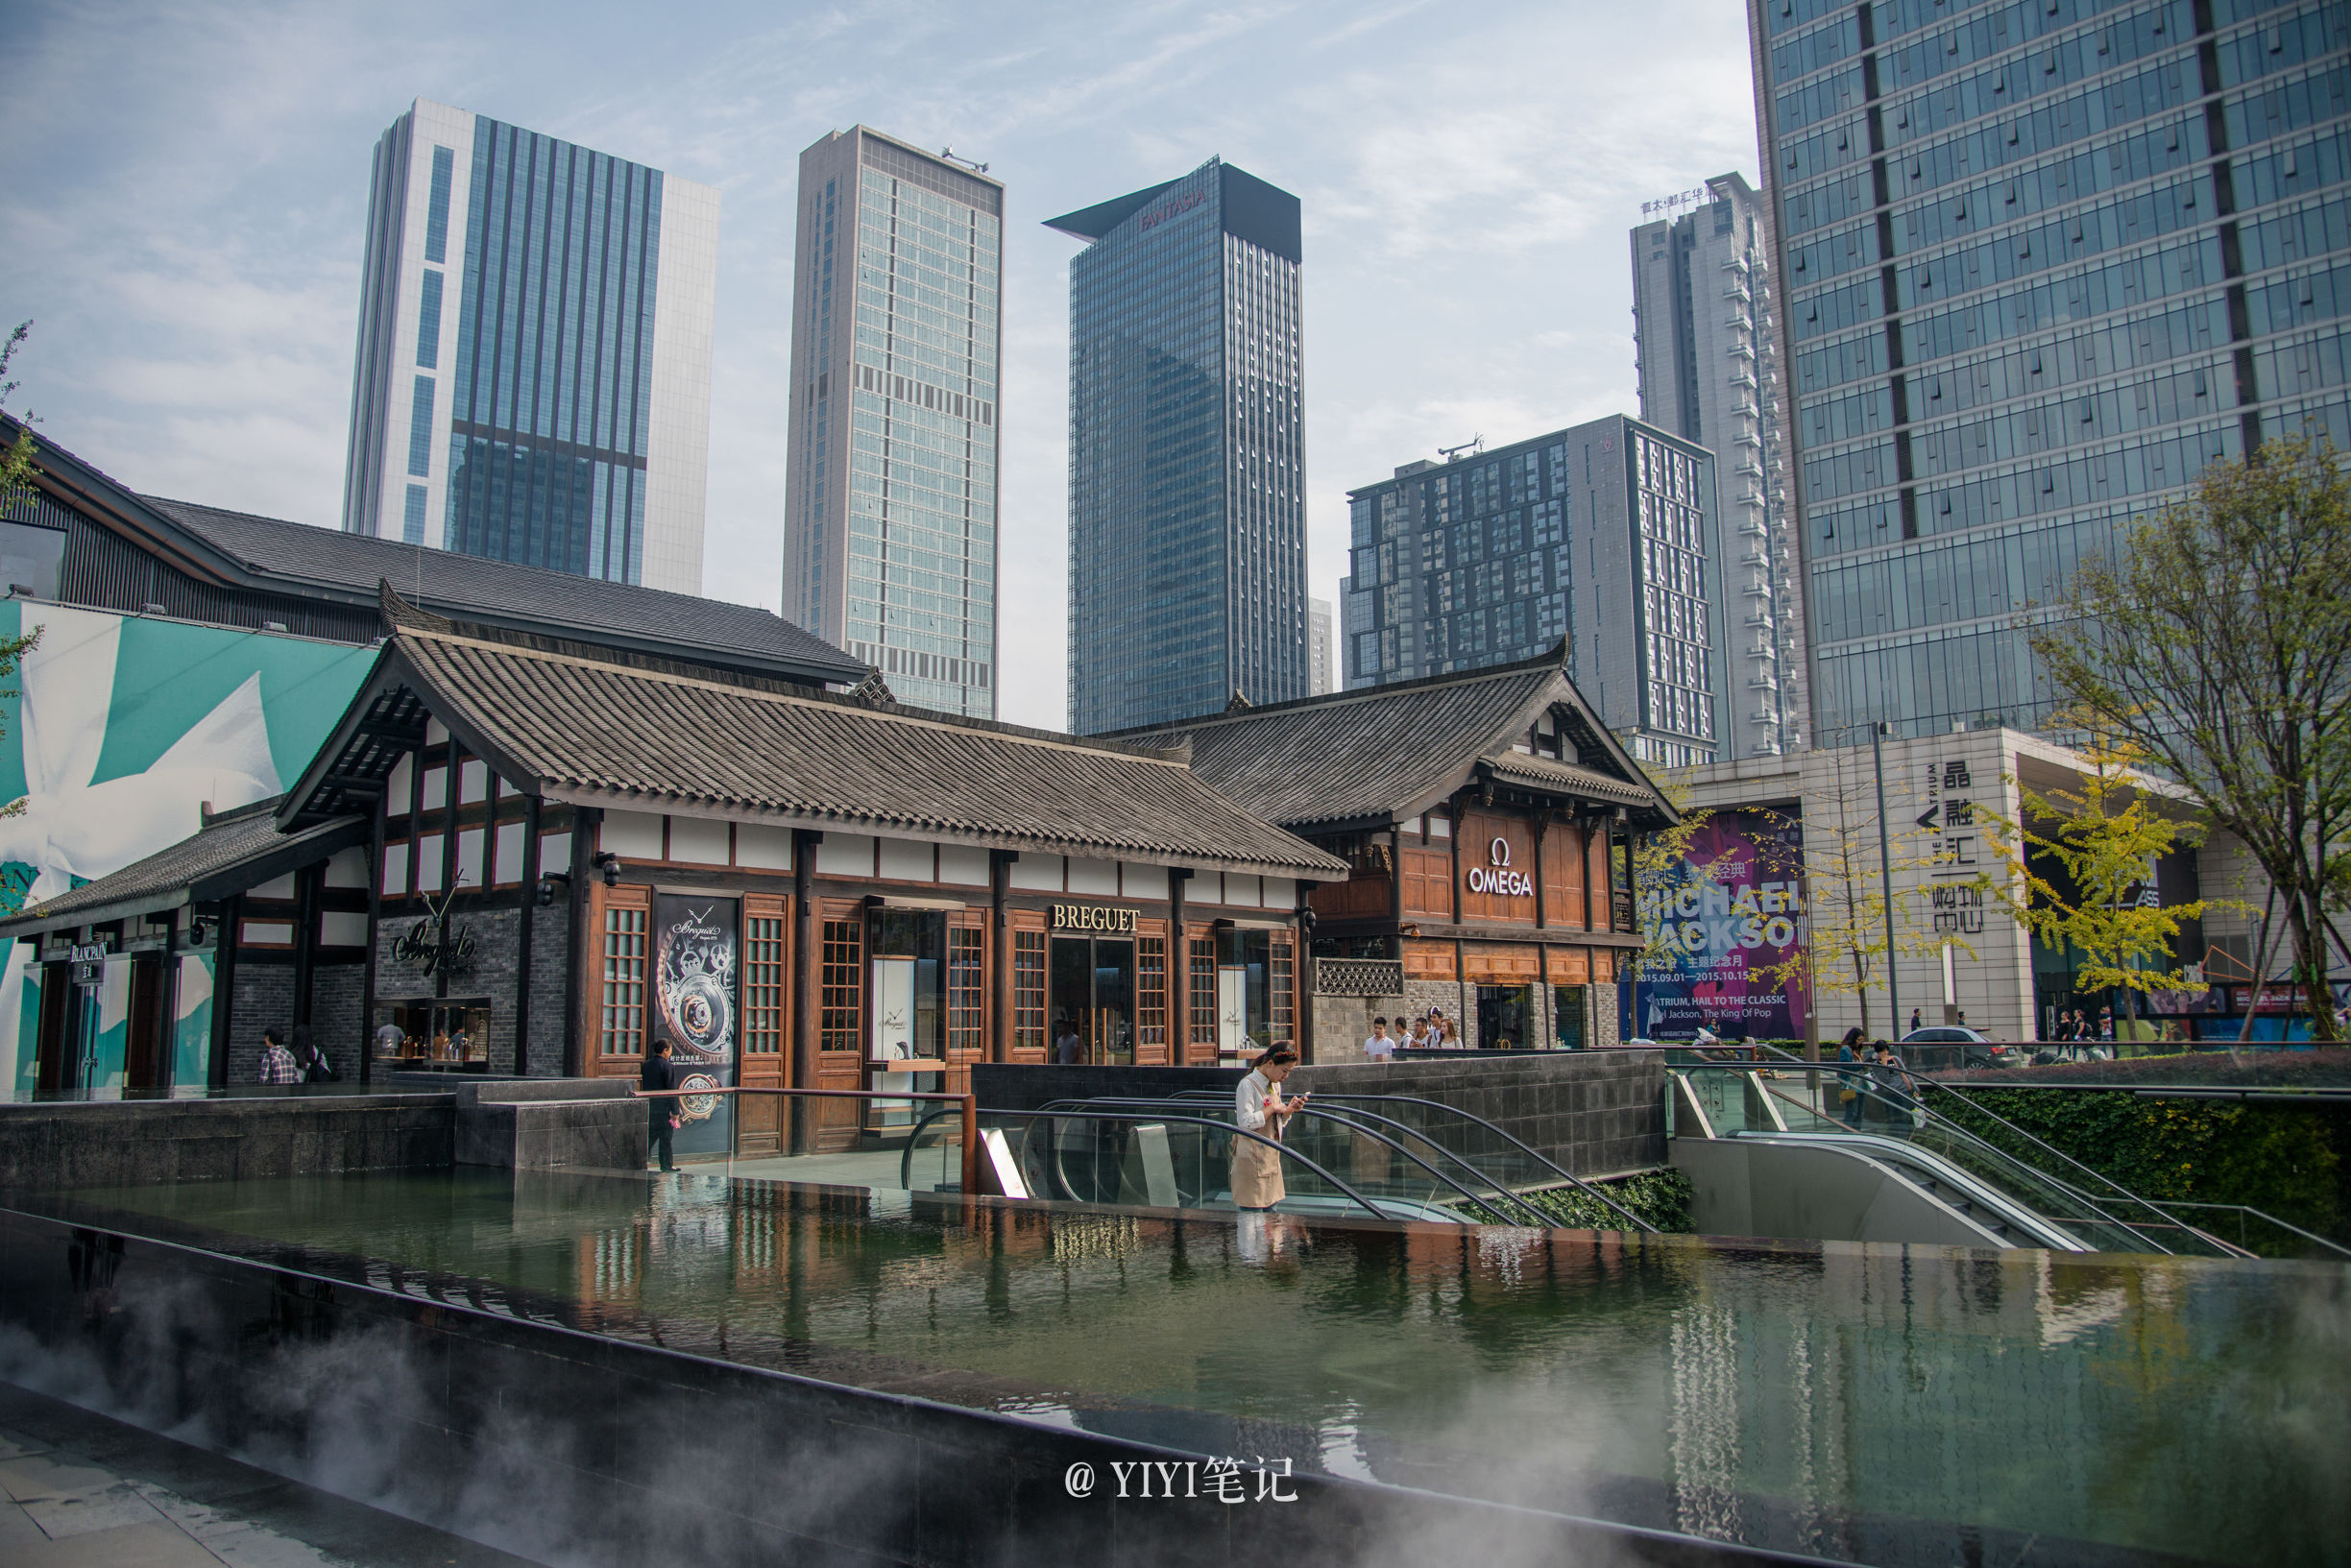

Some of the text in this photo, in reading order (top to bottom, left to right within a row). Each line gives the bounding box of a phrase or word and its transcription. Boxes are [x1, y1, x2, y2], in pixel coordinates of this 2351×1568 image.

[1140, 189, 1206, 232] FANTASIA
[1469, 867, 1533, 896] OMEGA
[1054, 905, 1140, 931] BREGUET
[672, 920, 721, 940] Breguet
[70, 942, 108, 963] BLANCPAIN
[1687, 954, 1742, 969] 主题纪念月
[1692, 997, 1712, 1005] HAIL
[1714, 996, 1727, 1005] TO
[1728, 996, 1746, 1004] THE
[1748, 995, 1786, 1004] CLASSIC
[1668, 1010, 1702, 1020] Jackson,
[1704, 1009, 1719, 1018] The
[1721, 1008, 1740, 1019] King
[1742, 1008, 1753, 1017] Of
[1755, 1008, 1772, 1019] Pop
